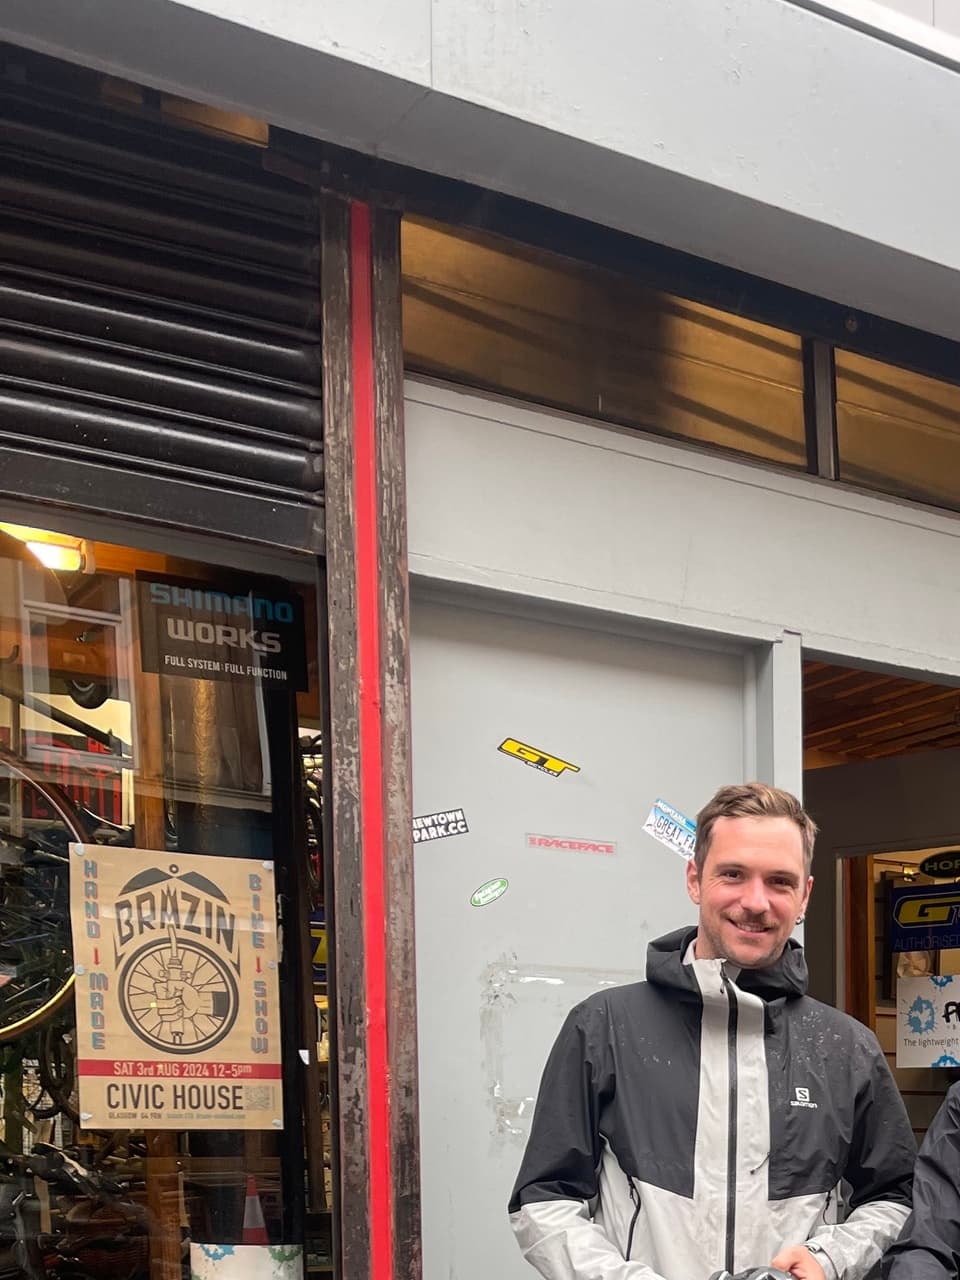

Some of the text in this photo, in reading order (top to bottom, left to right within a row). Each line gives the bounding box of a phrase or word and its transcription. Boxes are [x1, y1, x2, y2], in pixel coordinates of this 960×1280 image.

[166, 617, 282, 654] WORKS
[164, 654, 288, 681] FULL SYSTEM FULL FUNCTION
[499, 738, 581, 774] GT
[412, 821, 467, 842] PARK.CC
[656, 815, 683, 841] GREAT
[536, 838, 614, 854] RACEFACE
[83, 859, 101, 939] HAND
[89, 972, 109, 1050] MADE
[113, 1062, 135, 1075] SAT
[136, 1063, 154, 1076] 3rd
[156, 1063, 180, 1077] AUG
[182, 1063, 210, 1077] 2024
[106, 1082, 244, 1111] CIVIC HOUSE
